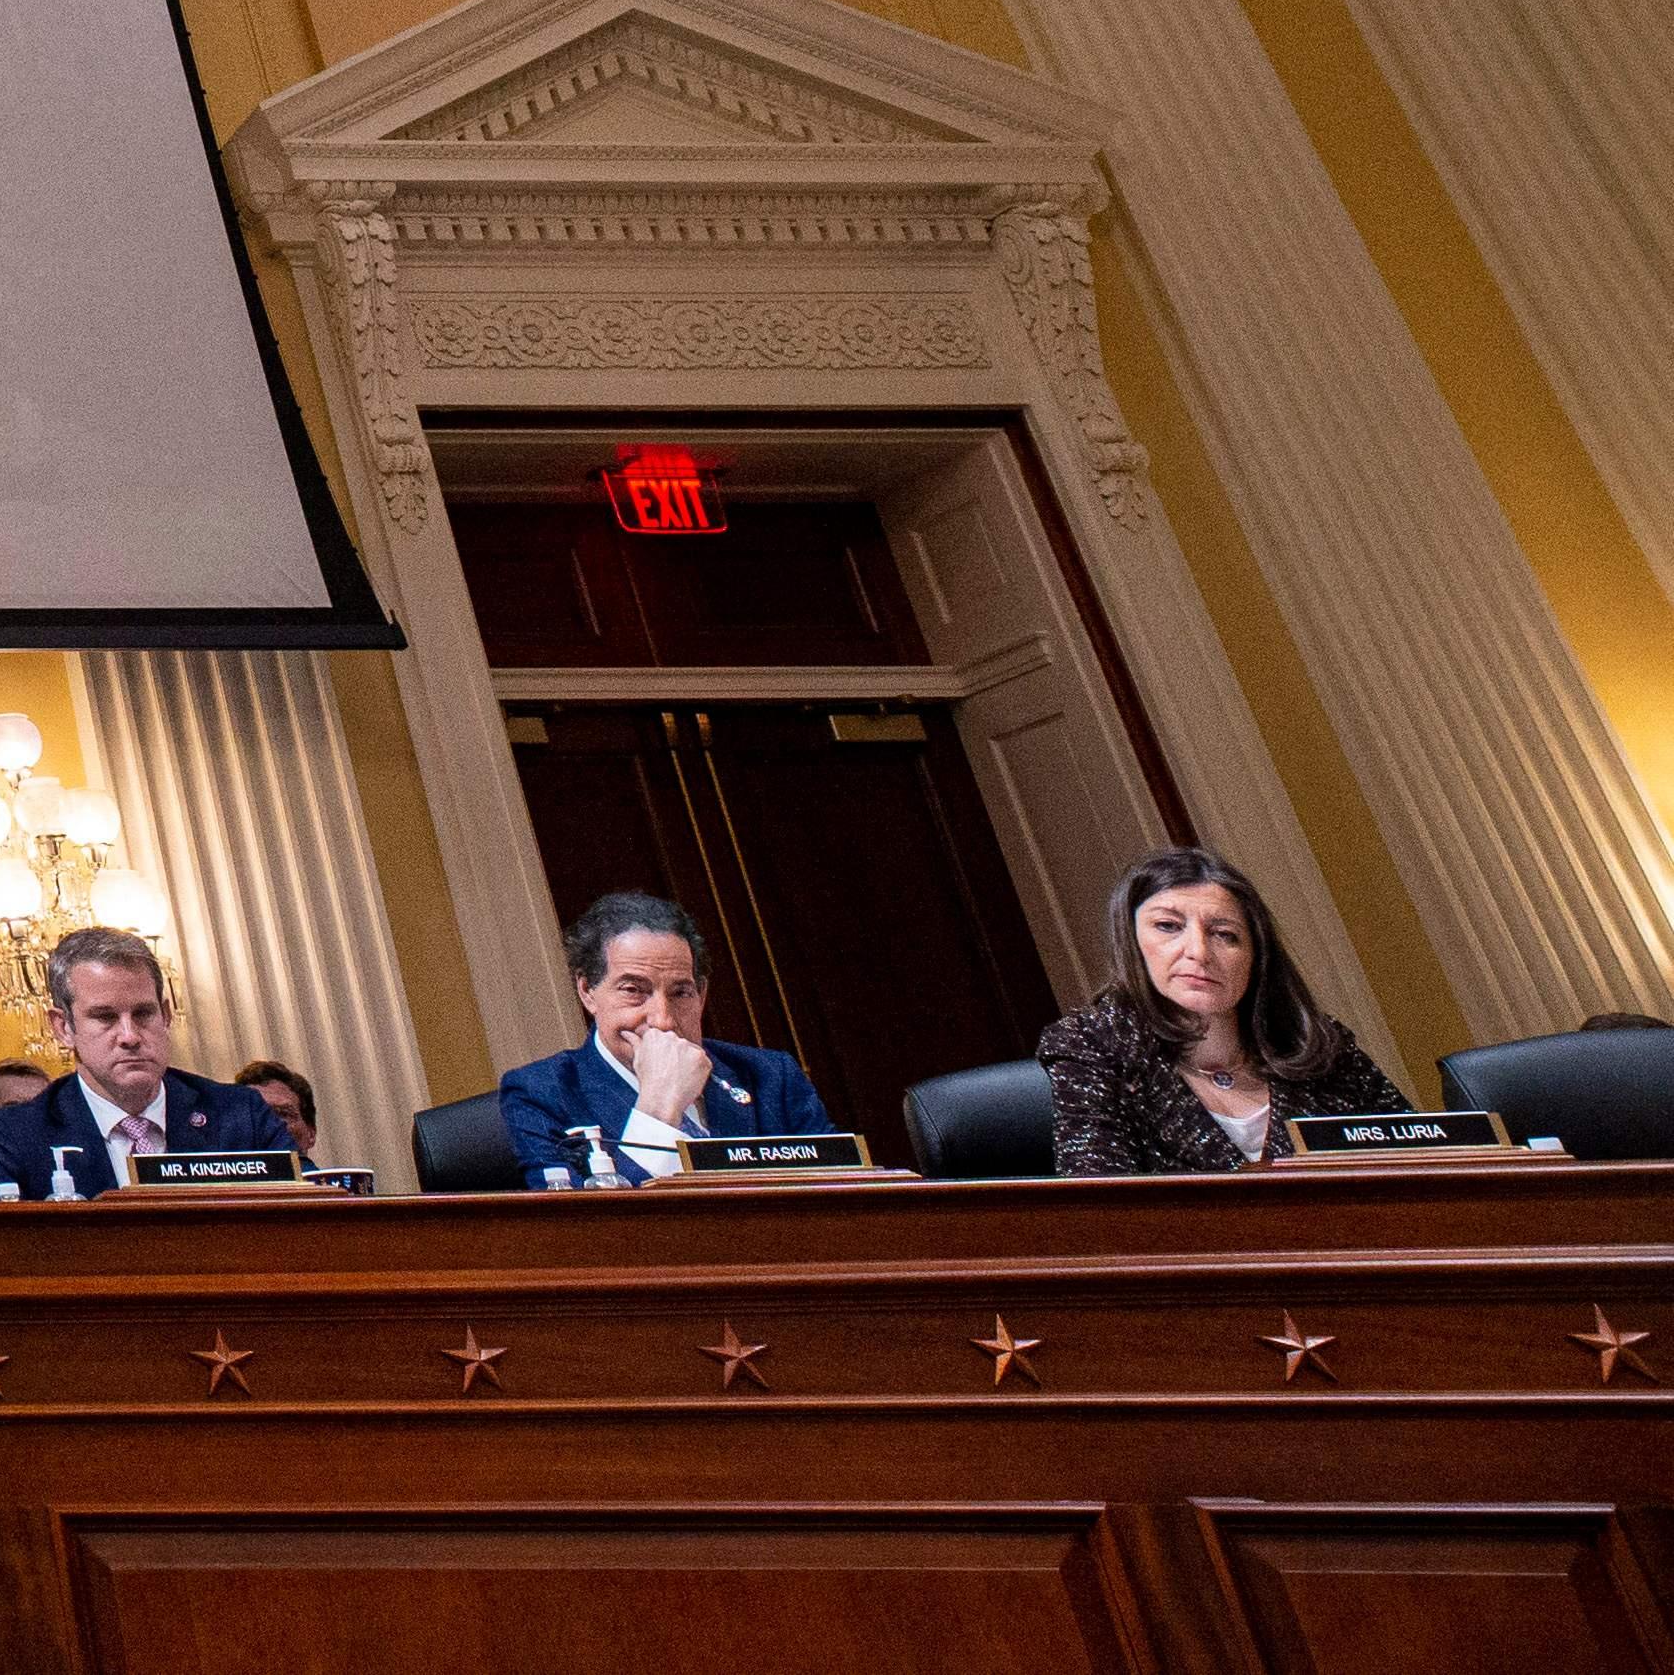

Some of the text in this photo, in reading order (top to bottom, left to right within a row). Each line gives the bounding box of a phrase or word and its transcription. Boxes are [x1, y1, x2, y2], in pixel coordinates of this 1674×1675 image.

[627, 479, 709, 528] EXIT
[1343, 1124, 1447, 1142] MRS. LURIA
[727, 1145, 819, 1162] MR. RASKIN
[160, 1160, 268, 1177] MR. KINZINGER
